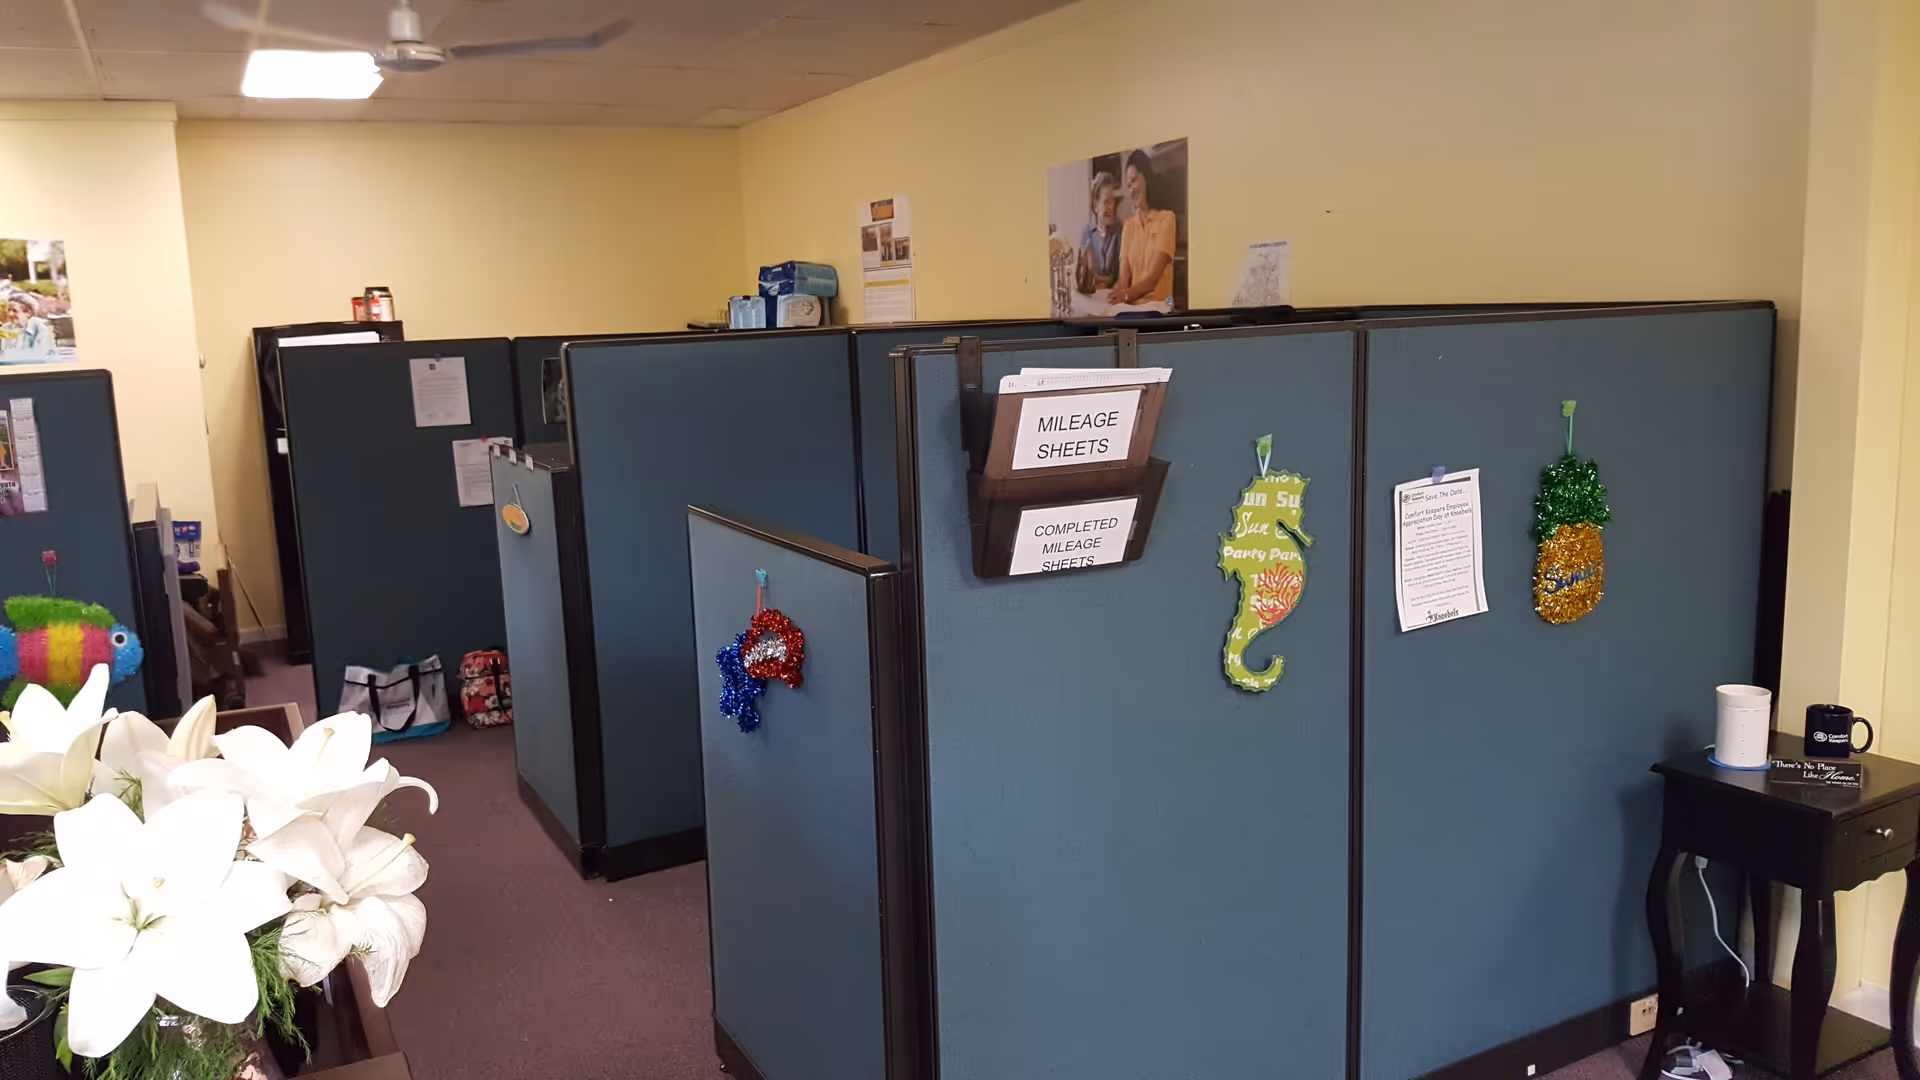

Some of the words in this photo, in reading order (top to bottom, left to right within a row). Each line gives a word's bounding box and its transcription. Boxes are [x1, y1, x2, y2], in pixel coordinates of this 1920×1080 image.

[1037, 411, 1120, 433] MILEAGE
[1037, 438, 1110, 459] SHEETS
[1425, 493, 1438, 502] Save
[1402, 516, 1433, 528] Appreciation
[1433, 513, 1443, 521] Day
[1444, 511, 1450, 519] at
[1450, 507, 1472, 517] Knoebels
[1405, 510, 1424, 520] Comfort
[1425, 505, 1446, 515] Keepers
[1446, 501, 1469, 511] Employee
[1034, 517, 1119, 538] COMPLETED
[1042, 537, 1103, 555] MILEAGE
[1223, 545, 1267, 562] Party
[1269, 547, 1302, 561] Par
[1432, 608, 1459, 623] Knoebels
[1803, 762, 1815, 770] No
[1817, 763, 1836, 771] Place
[1803, 771, 1819, 779] Like
